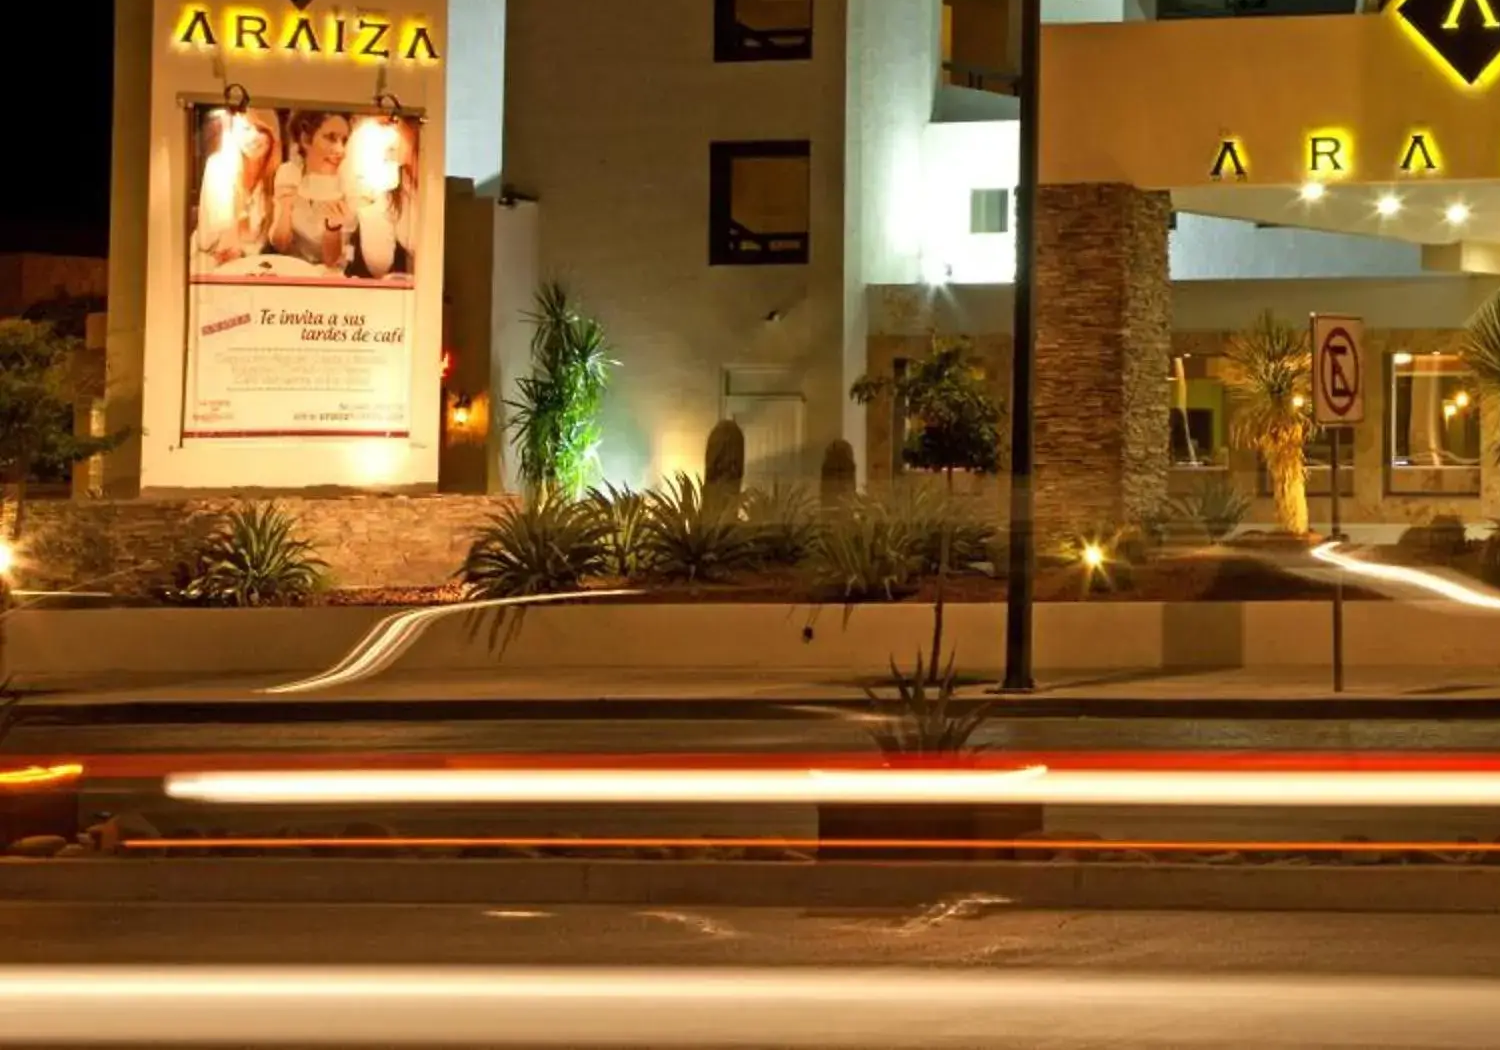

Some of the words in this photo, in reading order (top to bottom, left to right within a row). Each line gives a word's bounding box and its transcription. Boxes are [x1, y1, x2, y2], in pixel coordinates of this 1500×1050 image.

[181, 10, 440, 59] ARAIZA
[261, 309, 275, 325] Te
[280, 310, 323, 325] invita
[328, 313, 338, 326] a
[343, 314, 366, 326] sus
[301, 328, 347, 342] tardes
[351, 328, 370, 342] de
[373, 327, 405, 344] café
